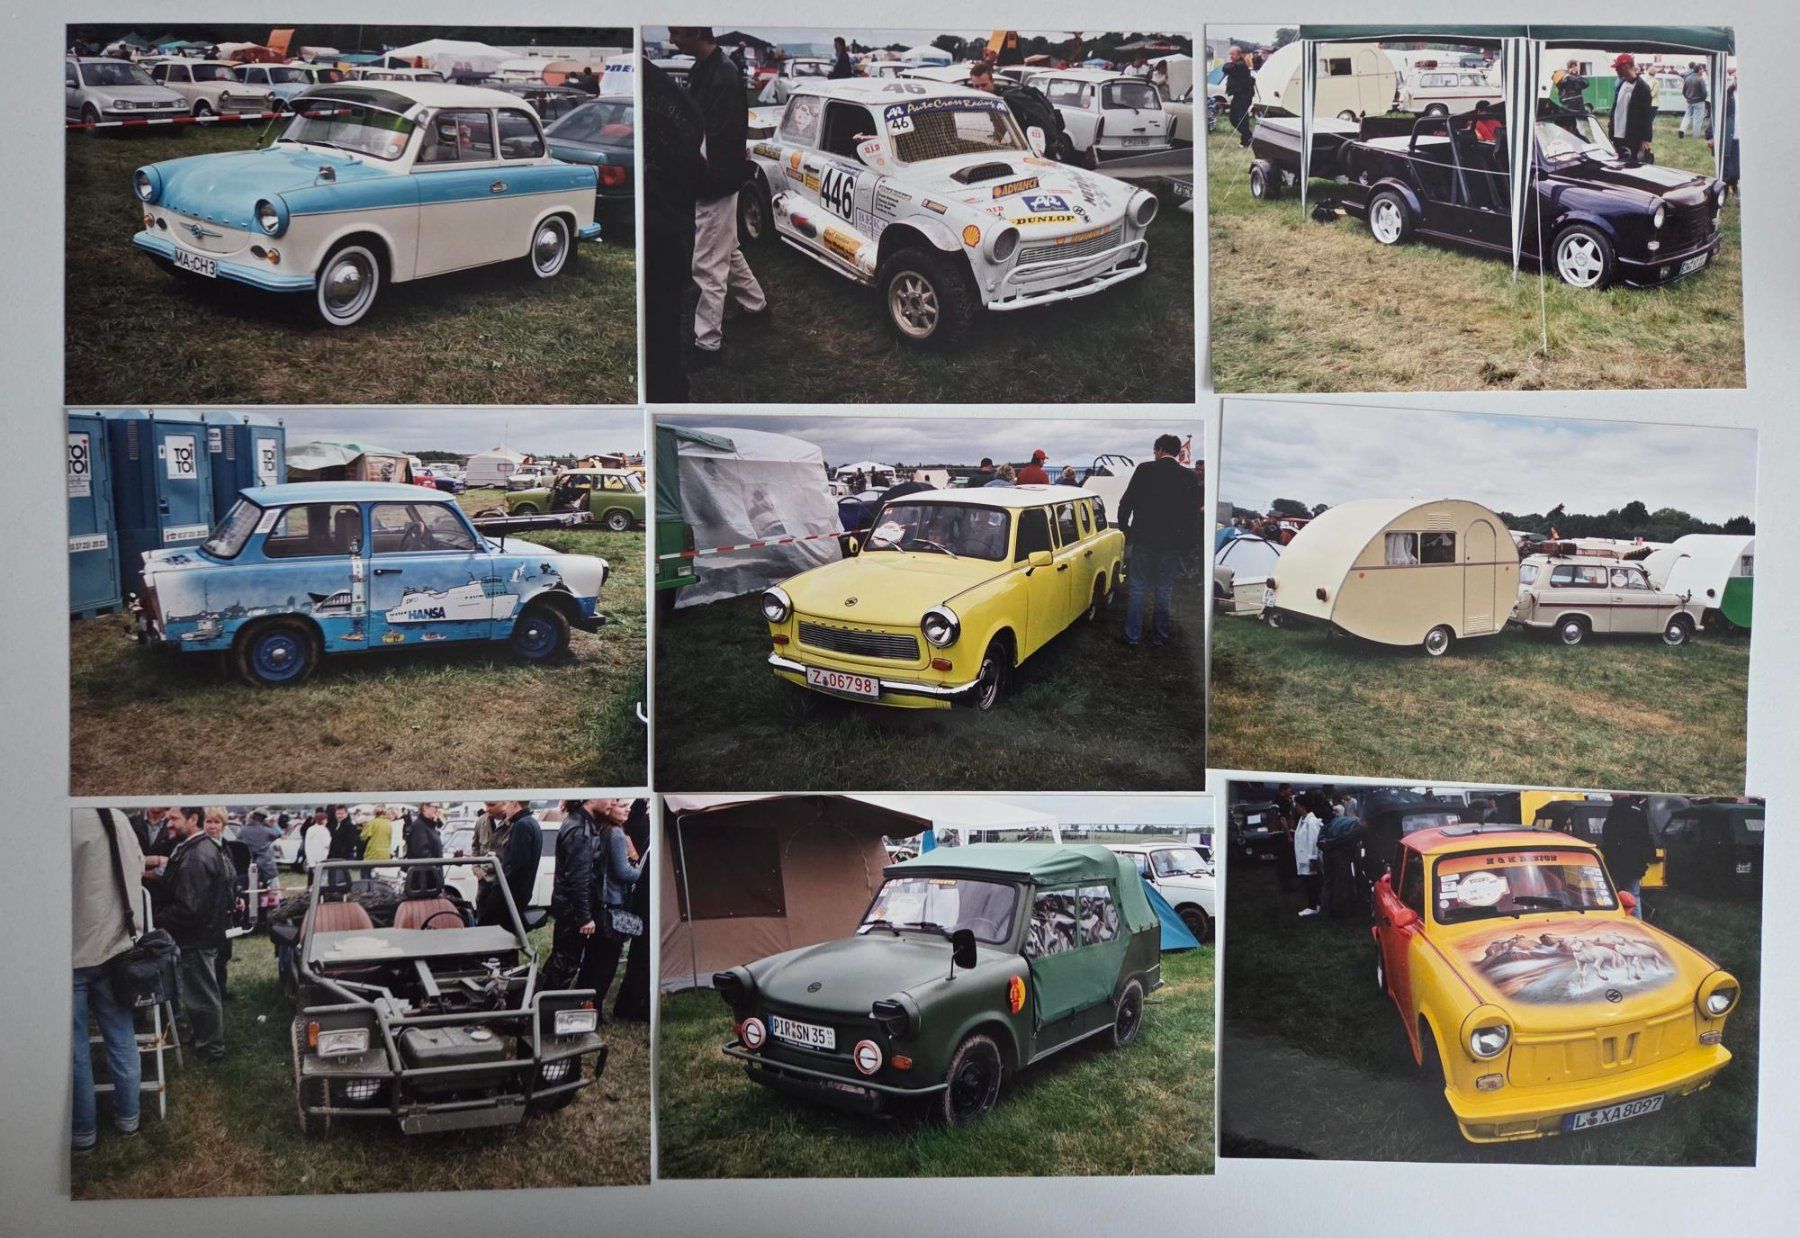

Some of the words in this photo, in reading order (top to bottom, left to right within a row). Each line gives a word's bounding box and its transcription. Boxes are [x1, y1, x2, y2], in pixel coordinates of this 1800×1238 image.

[882, 83, 926, 94] 46
[891, 117, 909, 129] 46
[821, 168, 854, 218] 446
[1001, 178, 1038, 195] ADVANCE
[1016, 215, 1075, 224] DUNLOP
[408, 606, 446, 619] HANSA
[812, 669, 822, 684] Z
[829, 673, 872, 693] 06798
[773, 1018, 791, 1037] PIR
[796, 1024, 809, 1041] SN
[811, 1027, 826, 1044] 35
[1599, 1107, 1620, 1123] XA
[1622, 1097, 1662, 1117] 8097
